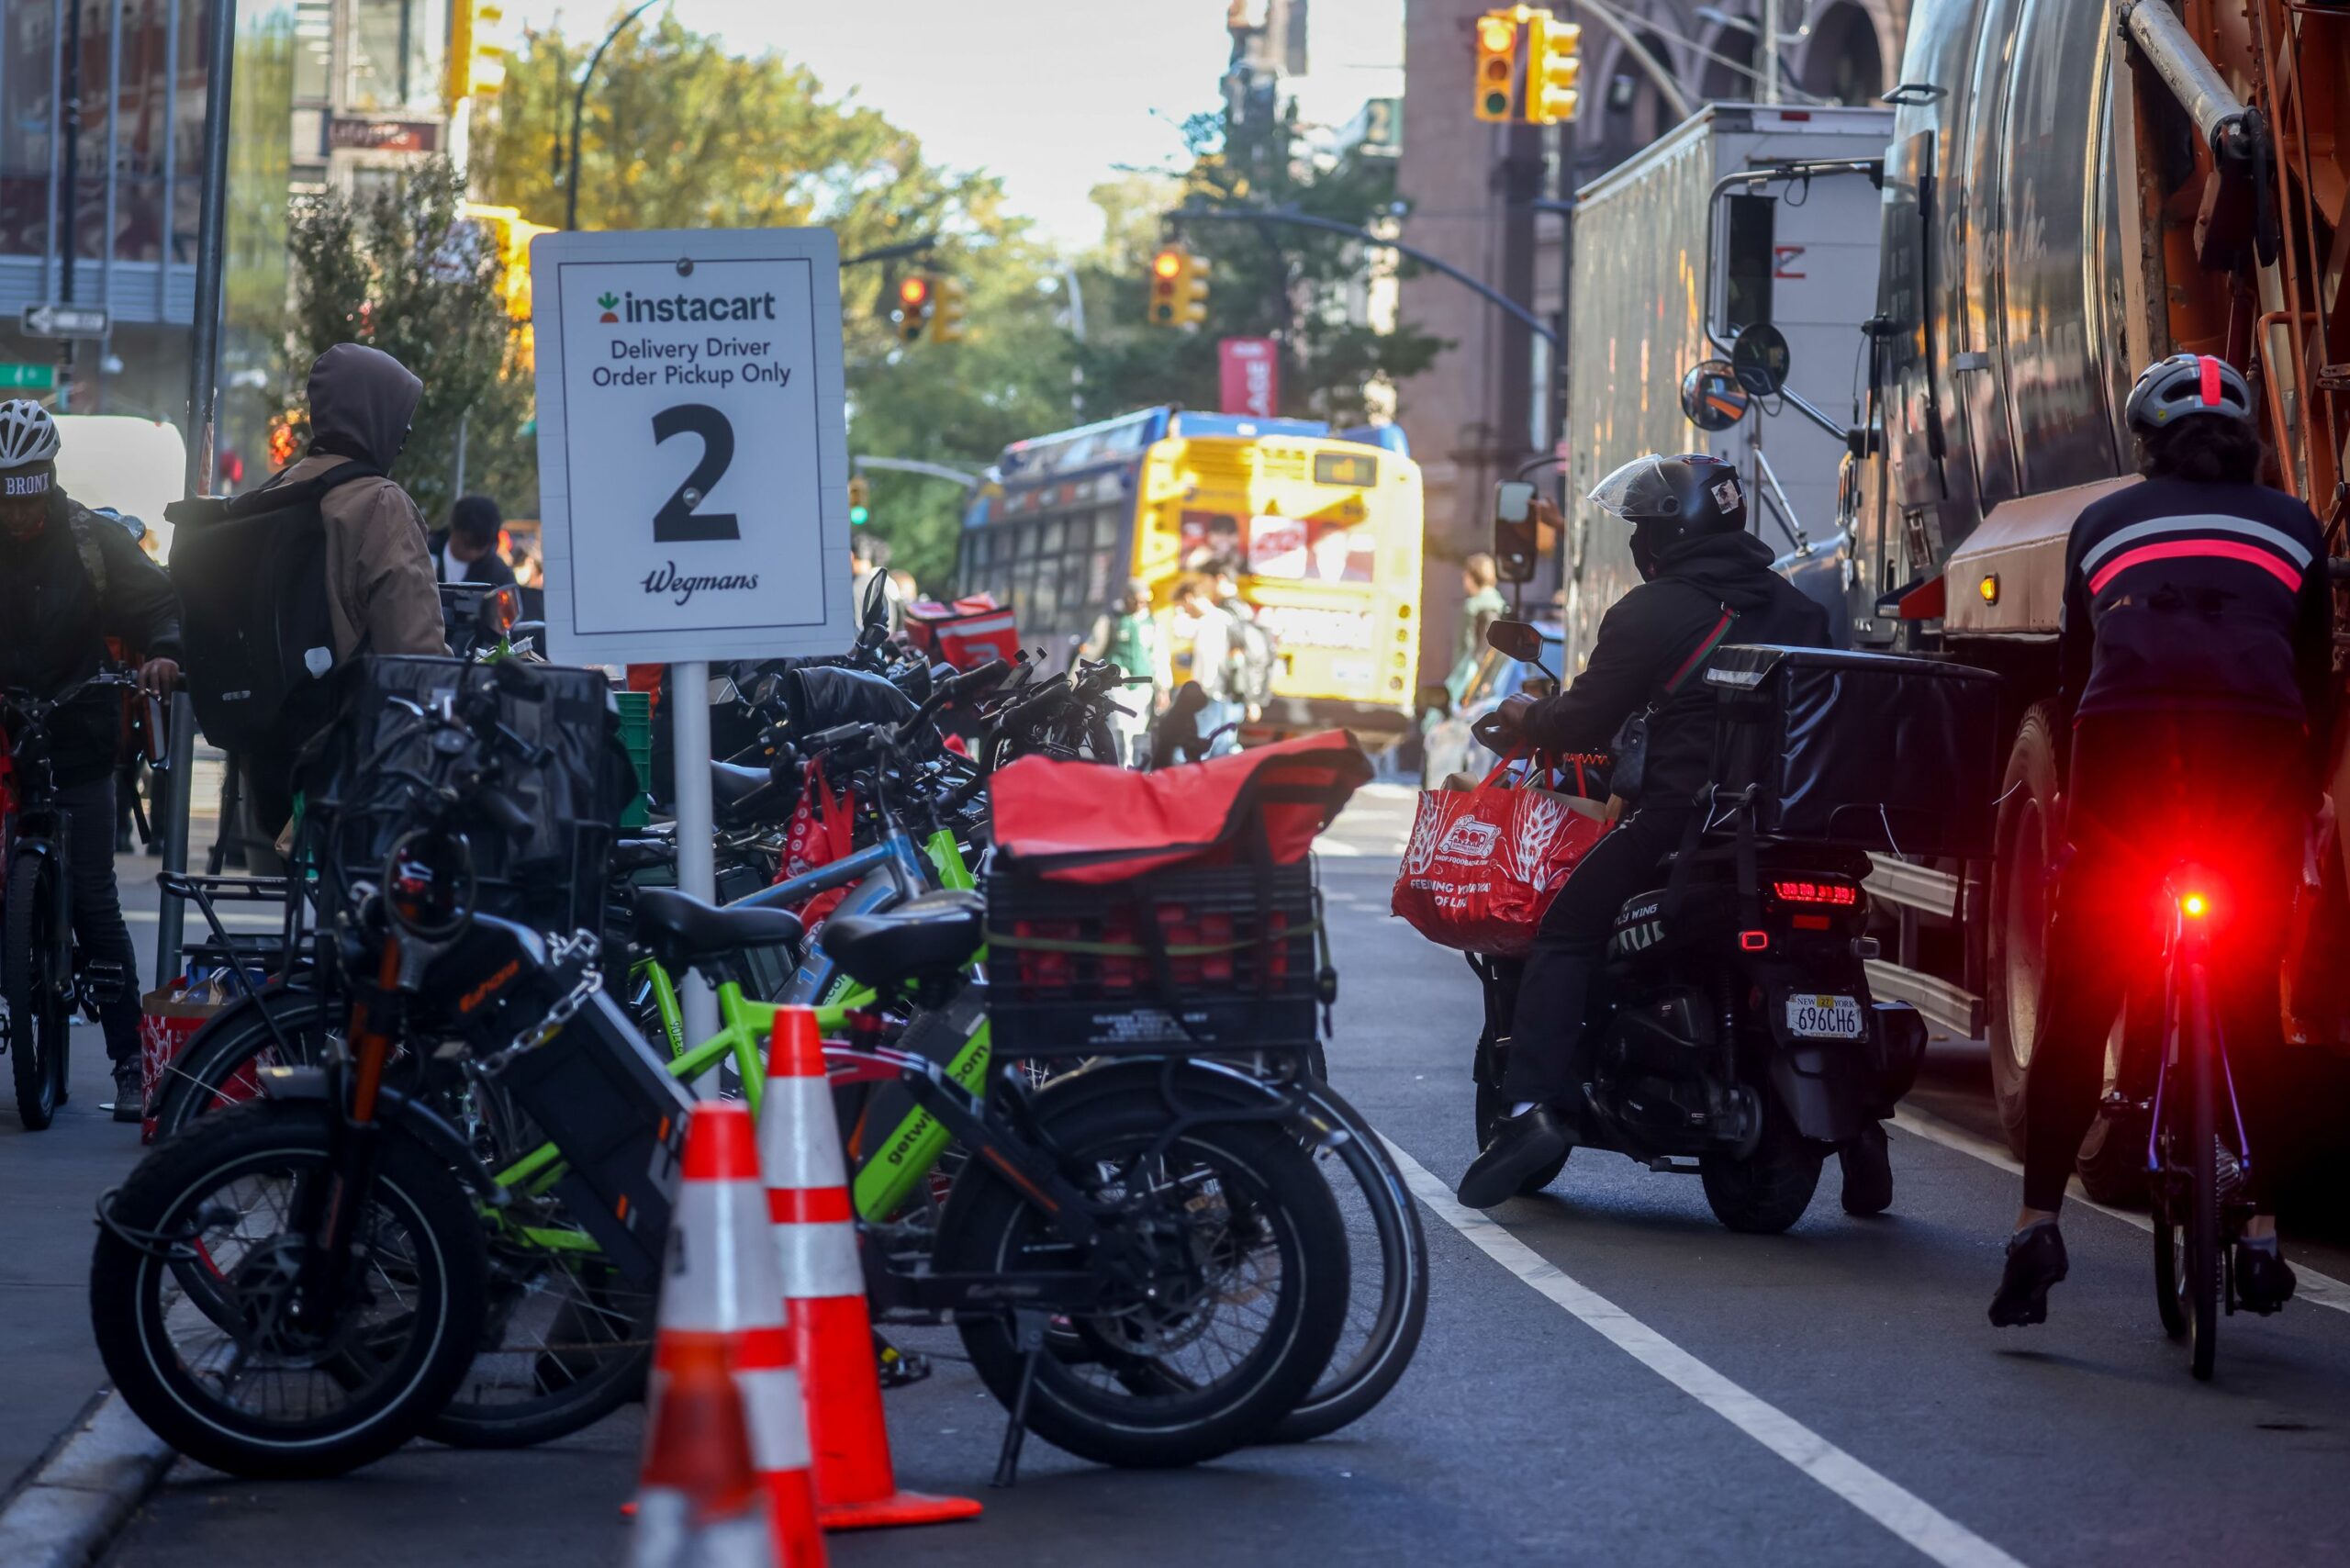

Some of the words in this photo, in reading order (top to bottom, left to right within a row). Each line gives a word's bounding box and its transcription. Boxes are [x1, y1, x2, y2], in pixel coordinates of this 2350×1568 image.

[625, 291, 776, 323] instacart
[611, 338, 699, 364] Delivery
[706, 337, 771, 357] Driver
[592, 364, 657, 387] Order
[665, 363, 734, 389] Pickup
[741, 361, 791, 387] Only
[5, 472, 49, 495] BRONX
[651, 403, 741, 543] 2
[639, 560, 759, 607] Wegmans
[1410, 879, 1454, 893] FEEDING
[1435, 894, 1449, 907] OF
[1449, 895, 1468, 908] LI
[1631, 903, 1659, 920] WING
[1797, 998, 1815, 1006] NEW
[1798, 1007, 1855, 1033] 696CH6
